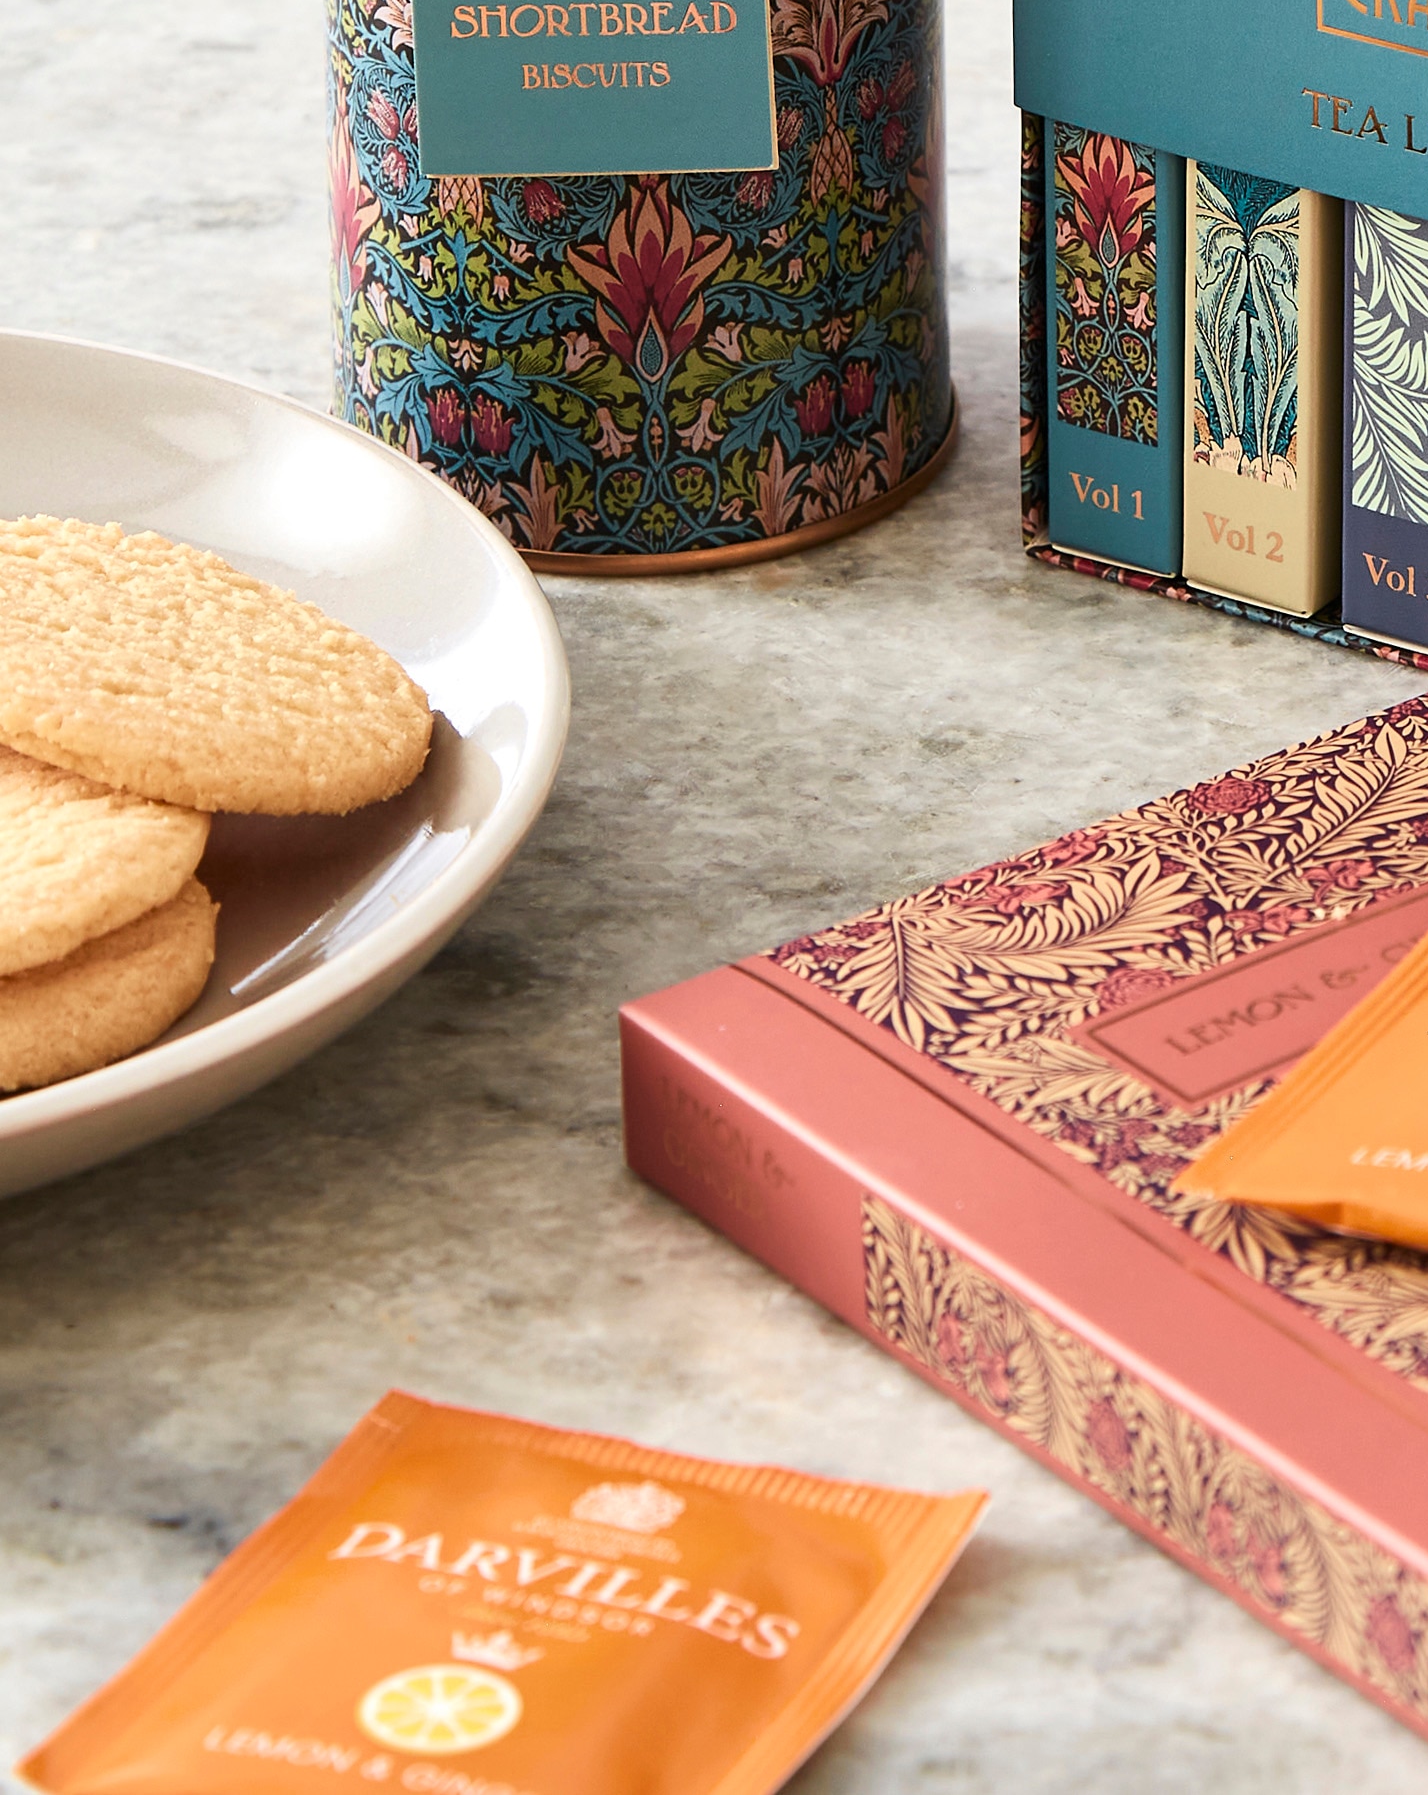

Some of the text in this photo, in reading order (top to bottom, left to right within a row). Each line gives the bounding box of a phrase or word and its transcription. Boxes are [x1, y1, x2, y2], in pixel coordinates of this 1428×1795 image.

[451, 1, 738, 39] SHORTBREAD
[522, 62, 671, 90] BISCUITS
[1301, 87, 1389, 145] TEA
[1069, 471, 1144, 521] Vol 1
[1203, 511, 1284, 563] Vol 2
[1362, 552, 1417, 597] Vol
[1166, 984, 1314, 1055] LEMON
[326, 1522, 800, 1661] DARVILLES
[418, 1574, 467, 1596] OF
[483, 1585, 656, 1637] WINDSOR
[202, 1724, 361, 1774] LEMON
